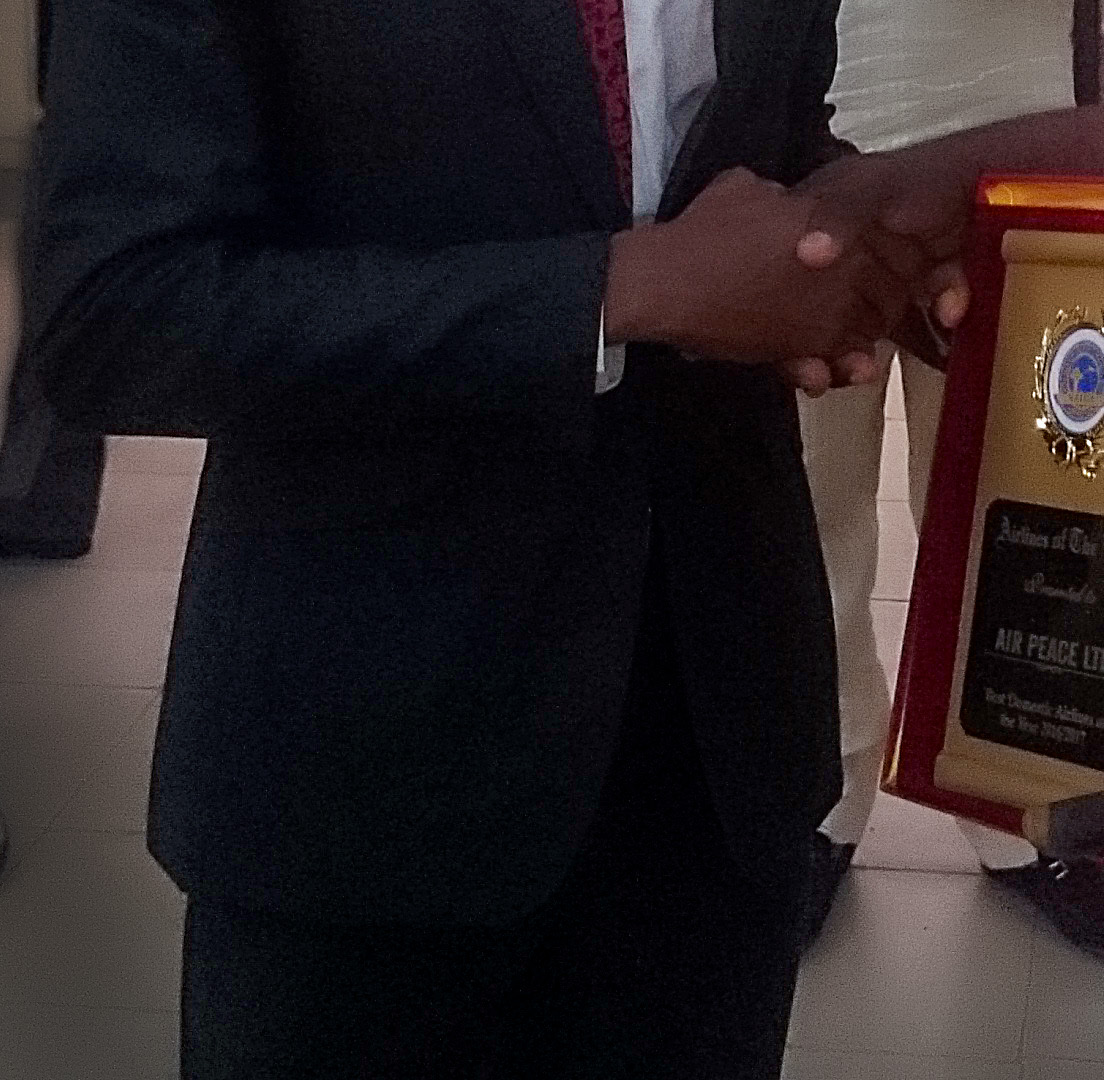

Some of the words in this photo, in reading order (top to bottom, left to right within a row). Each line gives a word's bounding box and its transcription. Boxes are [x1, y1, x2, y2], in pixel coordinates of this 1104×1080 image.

[1052, 528, 1068, 550] of
[995, 628, 1022, 654] AIR
[1028, 634, 1079, 668] PEACE
